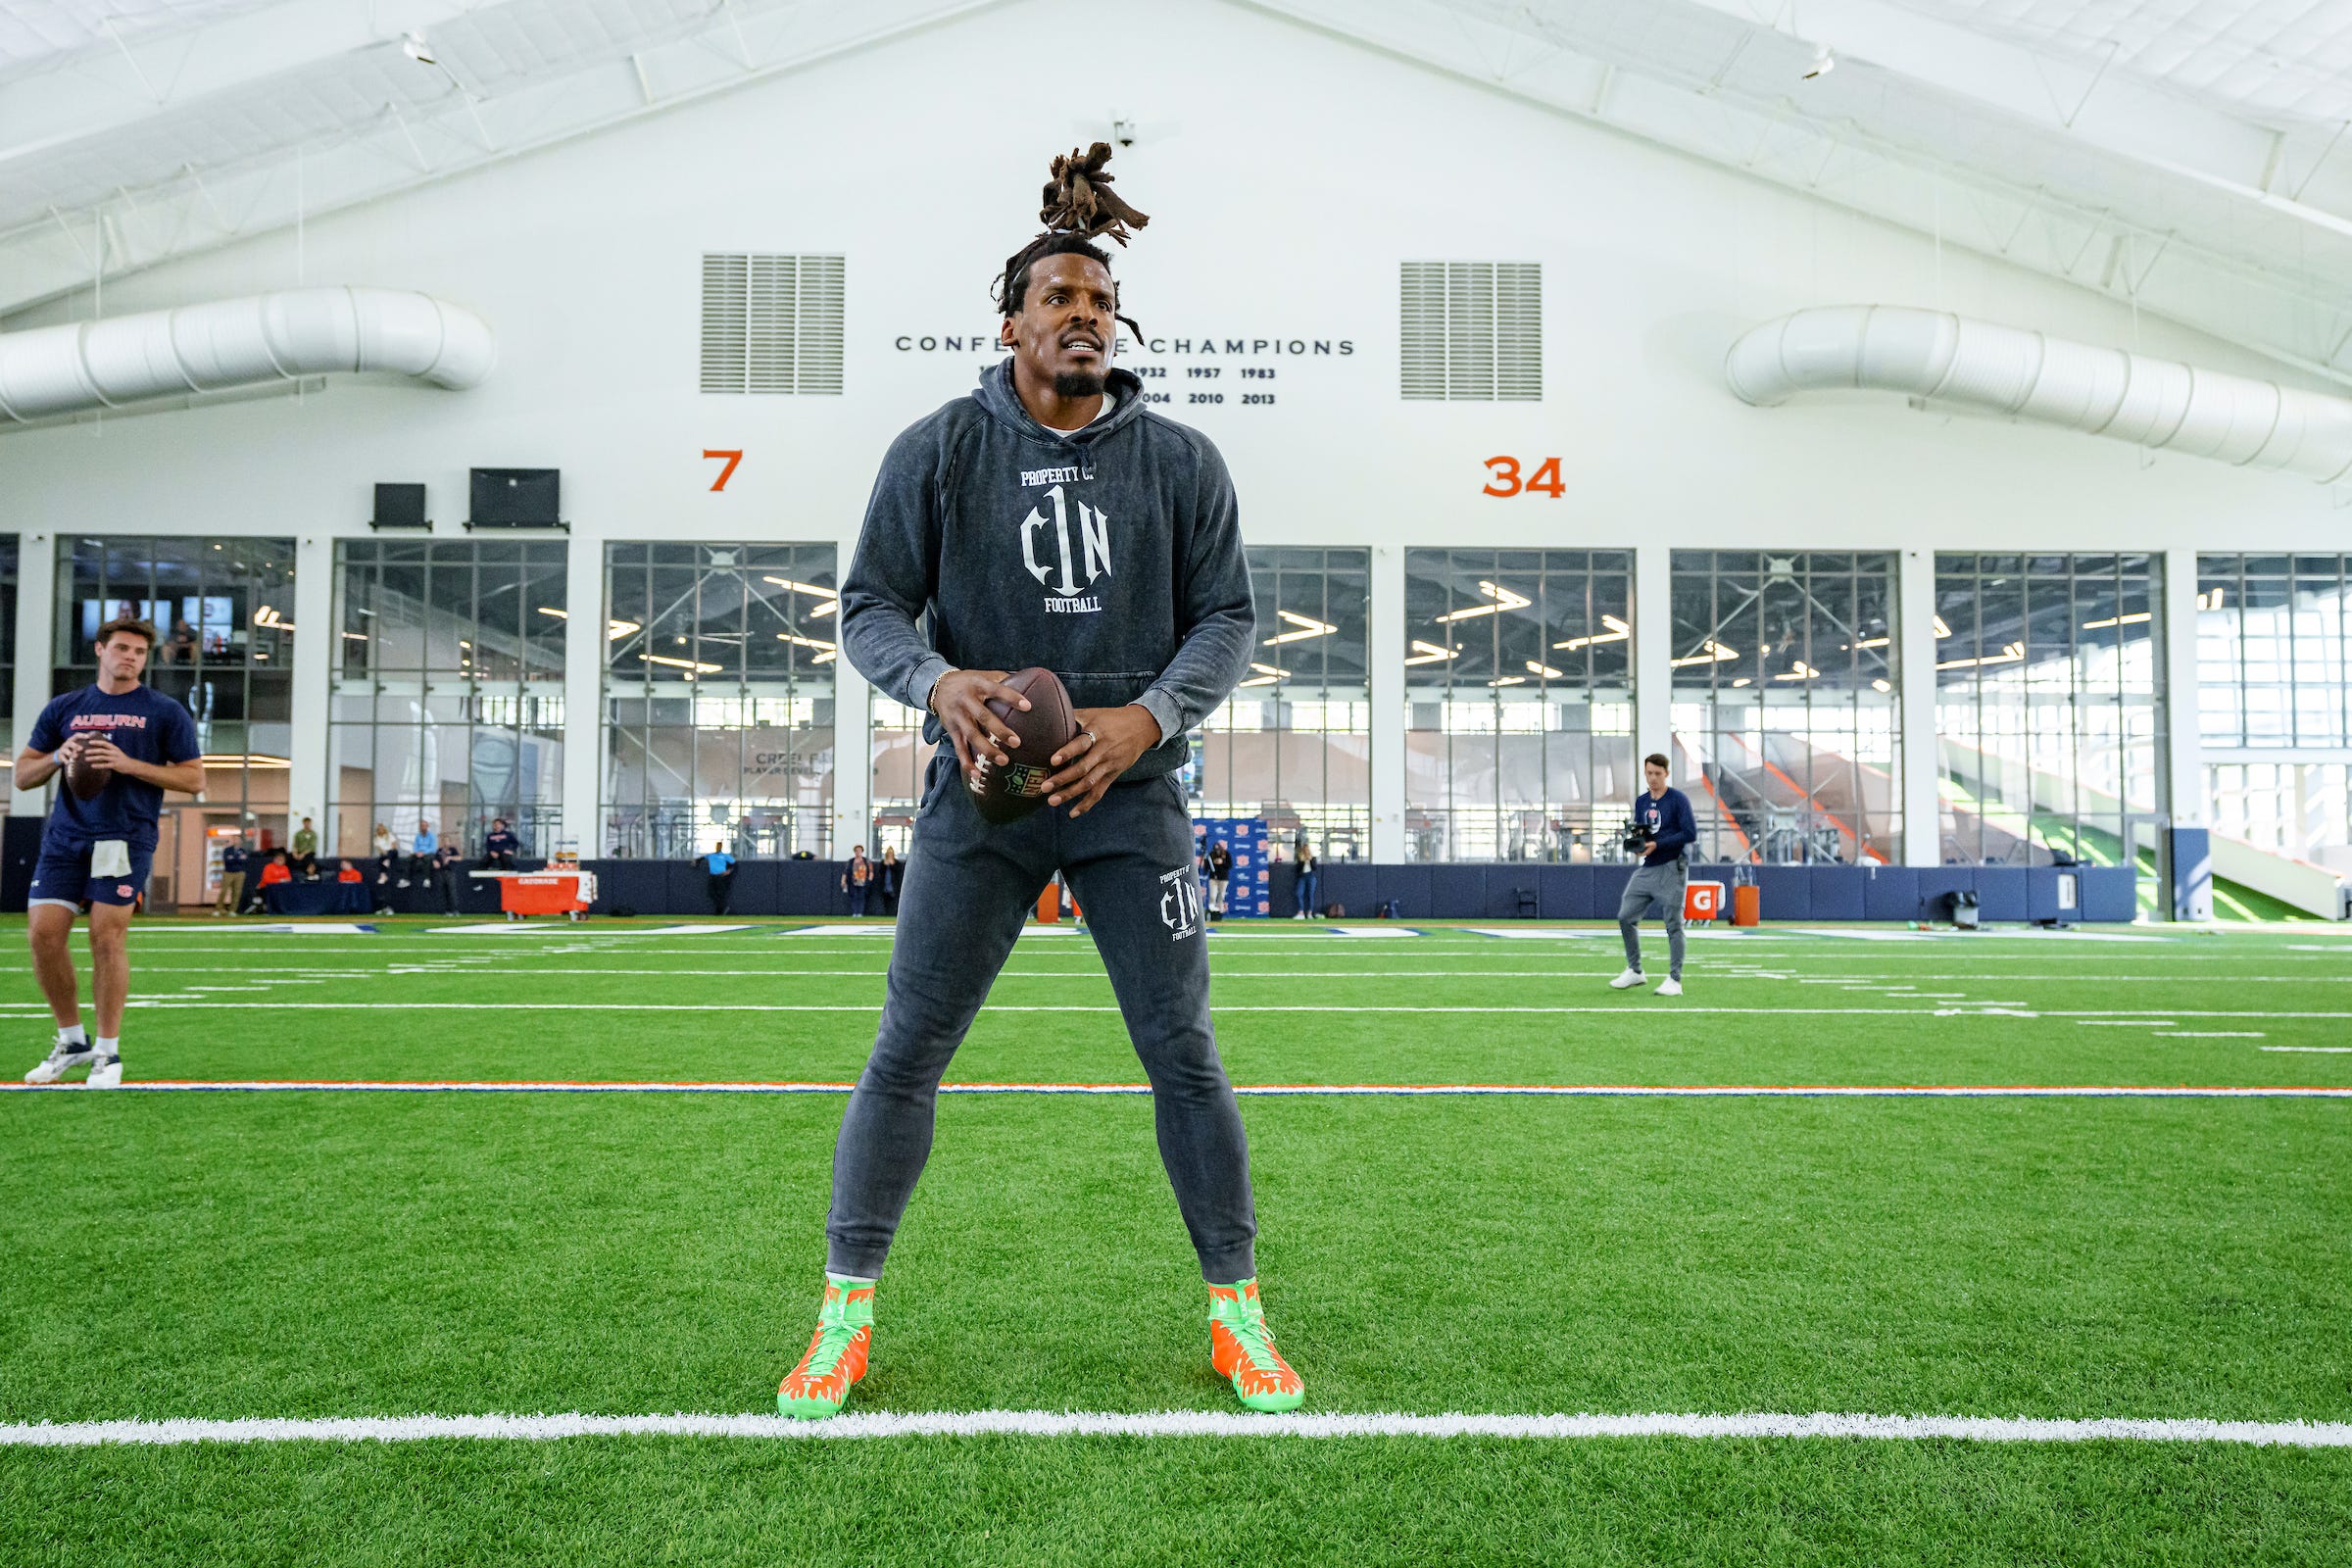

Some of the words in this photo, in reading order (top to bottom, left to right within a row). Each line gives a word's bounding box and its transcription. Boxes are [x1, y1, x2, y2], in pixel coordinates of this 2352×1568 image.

[896, 336, 1128, 353] CONFEE
[1150, 338, 1354, 355] CHAMPIONS
[1187, 368, 1221, 378] 1957
[1241, 368, 1276, 379] 1983
[1142, 393, 1171, 403] 004
[1188, 393, 1224, 404] 2010
[1241, 393, 1276, 405] 2013
[703, 449, 743, 492] 7
[1020, 466, 1078, 487] PROPERTY
[1482, 456, 1566, 498] 34
[1044, 596, 1102, 613] FOOTBALL
[70, 714, 147, 728] AUBURN
[1159, 867, 1186, 885] PROPERTY
[1692, 890, 1712, 910] G
[1172, 926, 1197, 942] FOOTBALL
